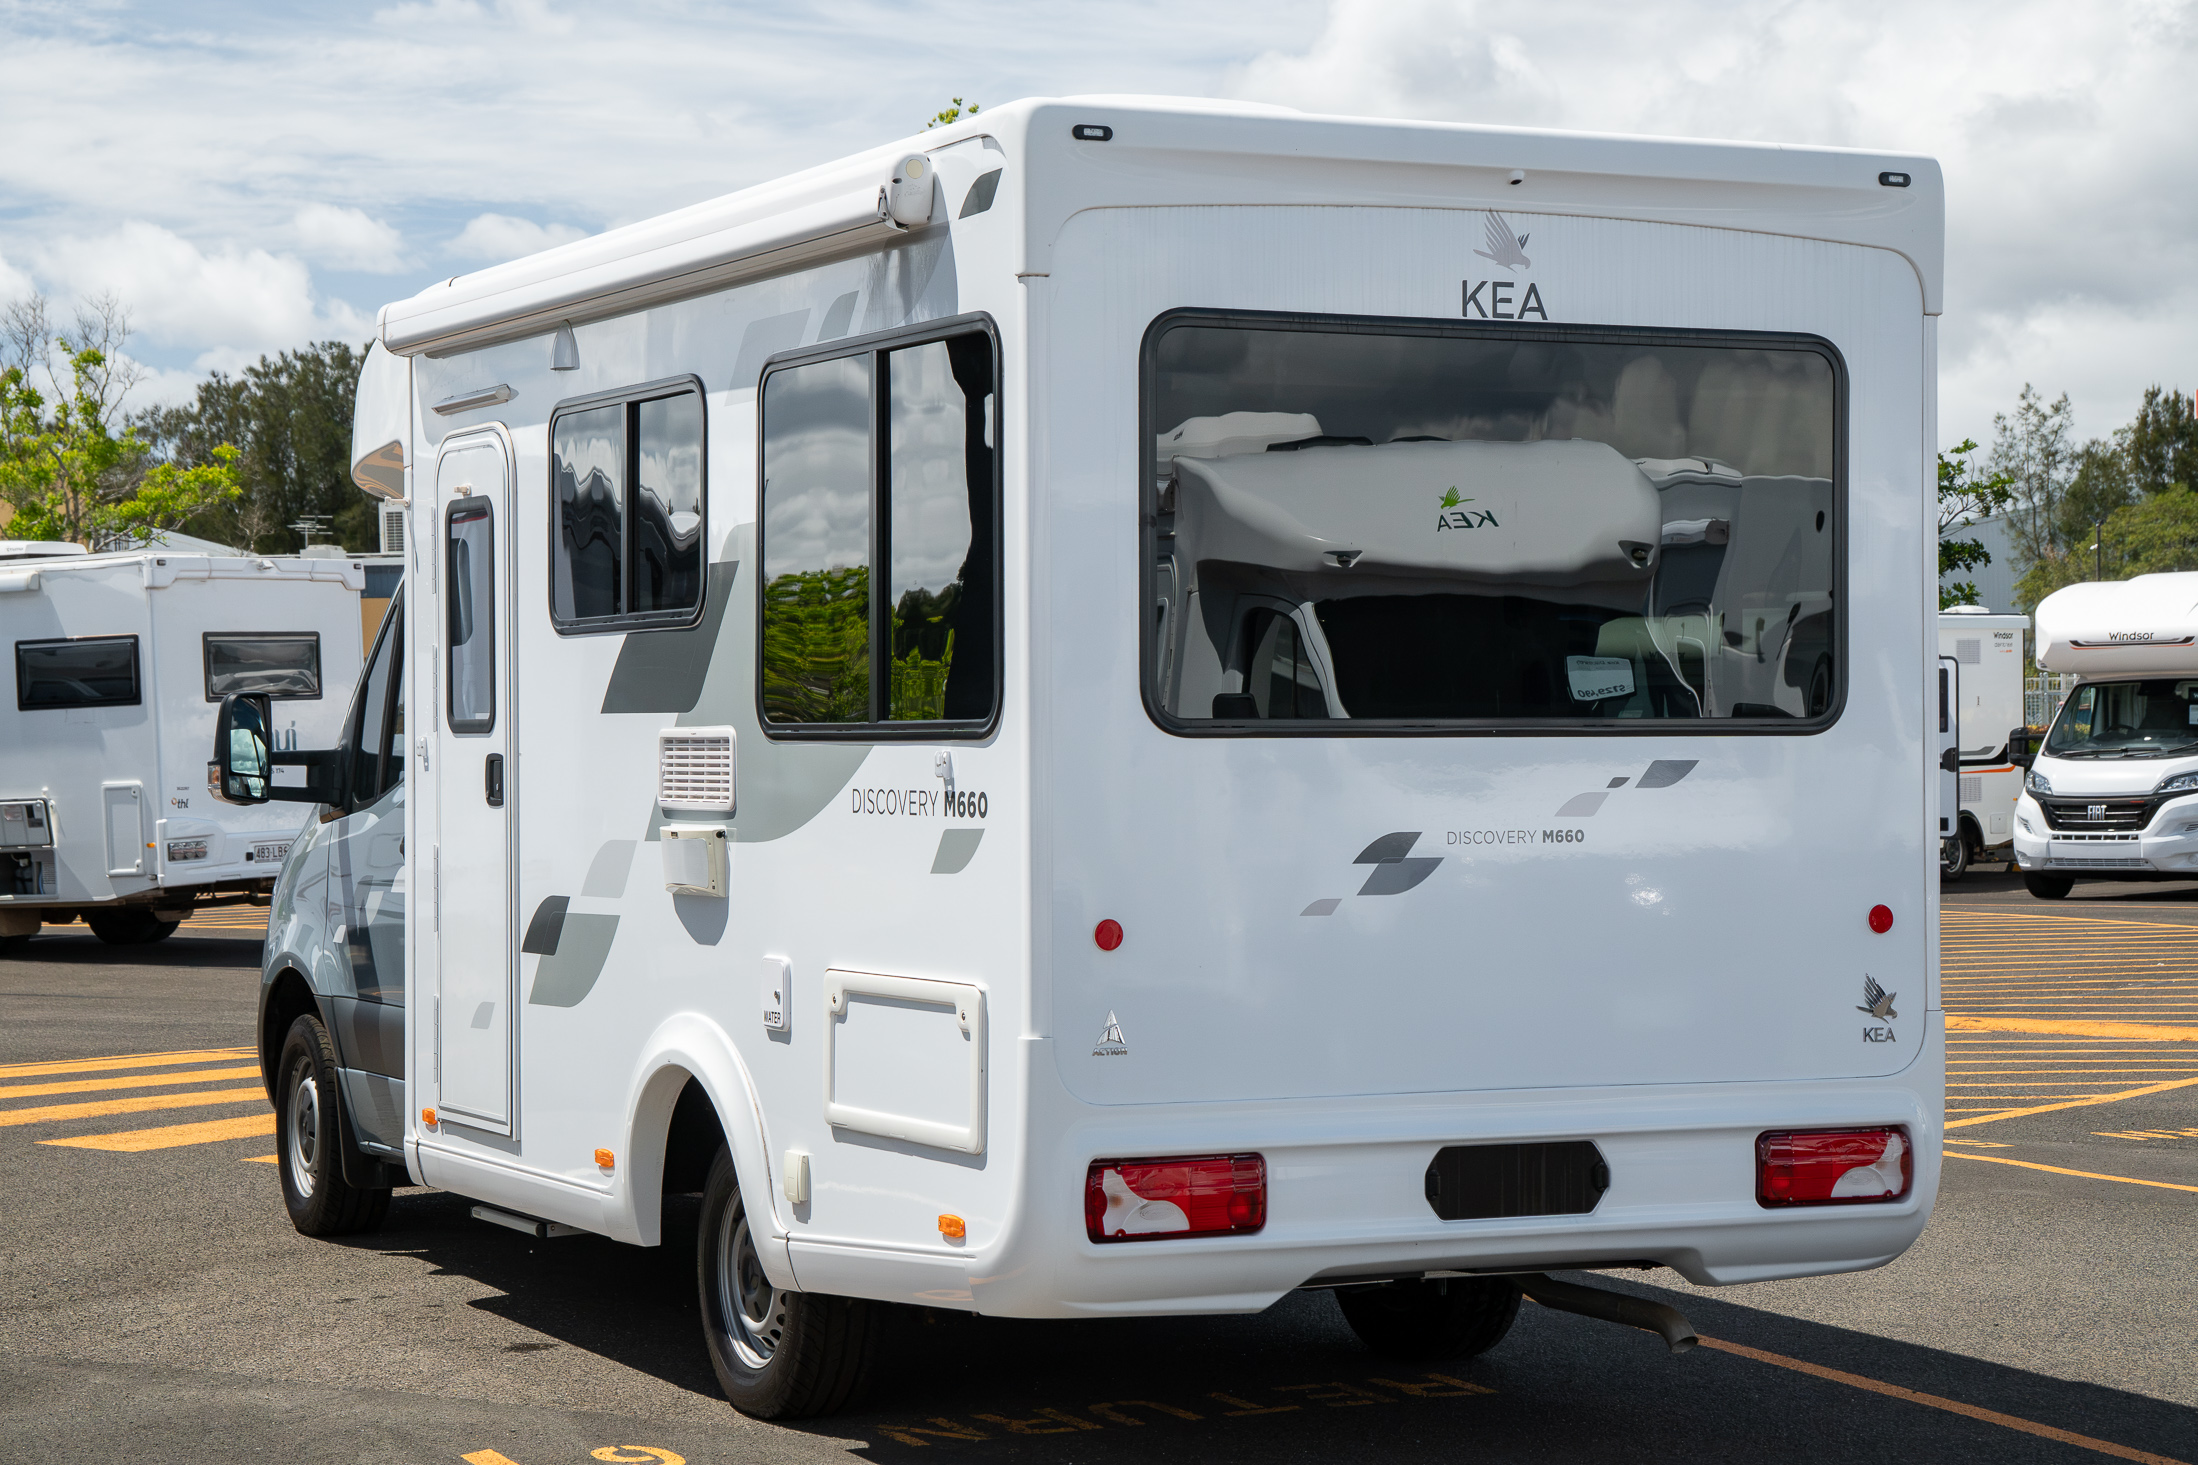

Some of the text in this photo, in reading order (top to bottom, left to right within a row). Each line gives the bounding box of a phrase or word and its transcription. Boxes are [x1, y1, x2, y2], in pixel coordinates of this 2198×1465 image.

[1461, 279, 1549, 321] KEA
[2109, 631, 2154, 641] Windsor
[852, 788, 988, 818] DISCOVERY M660
[2087, 804, 2107, 821] FIAT
[1447, 828, 1585, 845] DISCOVERY M660
[763, 1010, 781, 1025] WATER
[1862, 1026, 1896, 1043] KEA
[1092, 1047, 1128, 1057] ACTION
